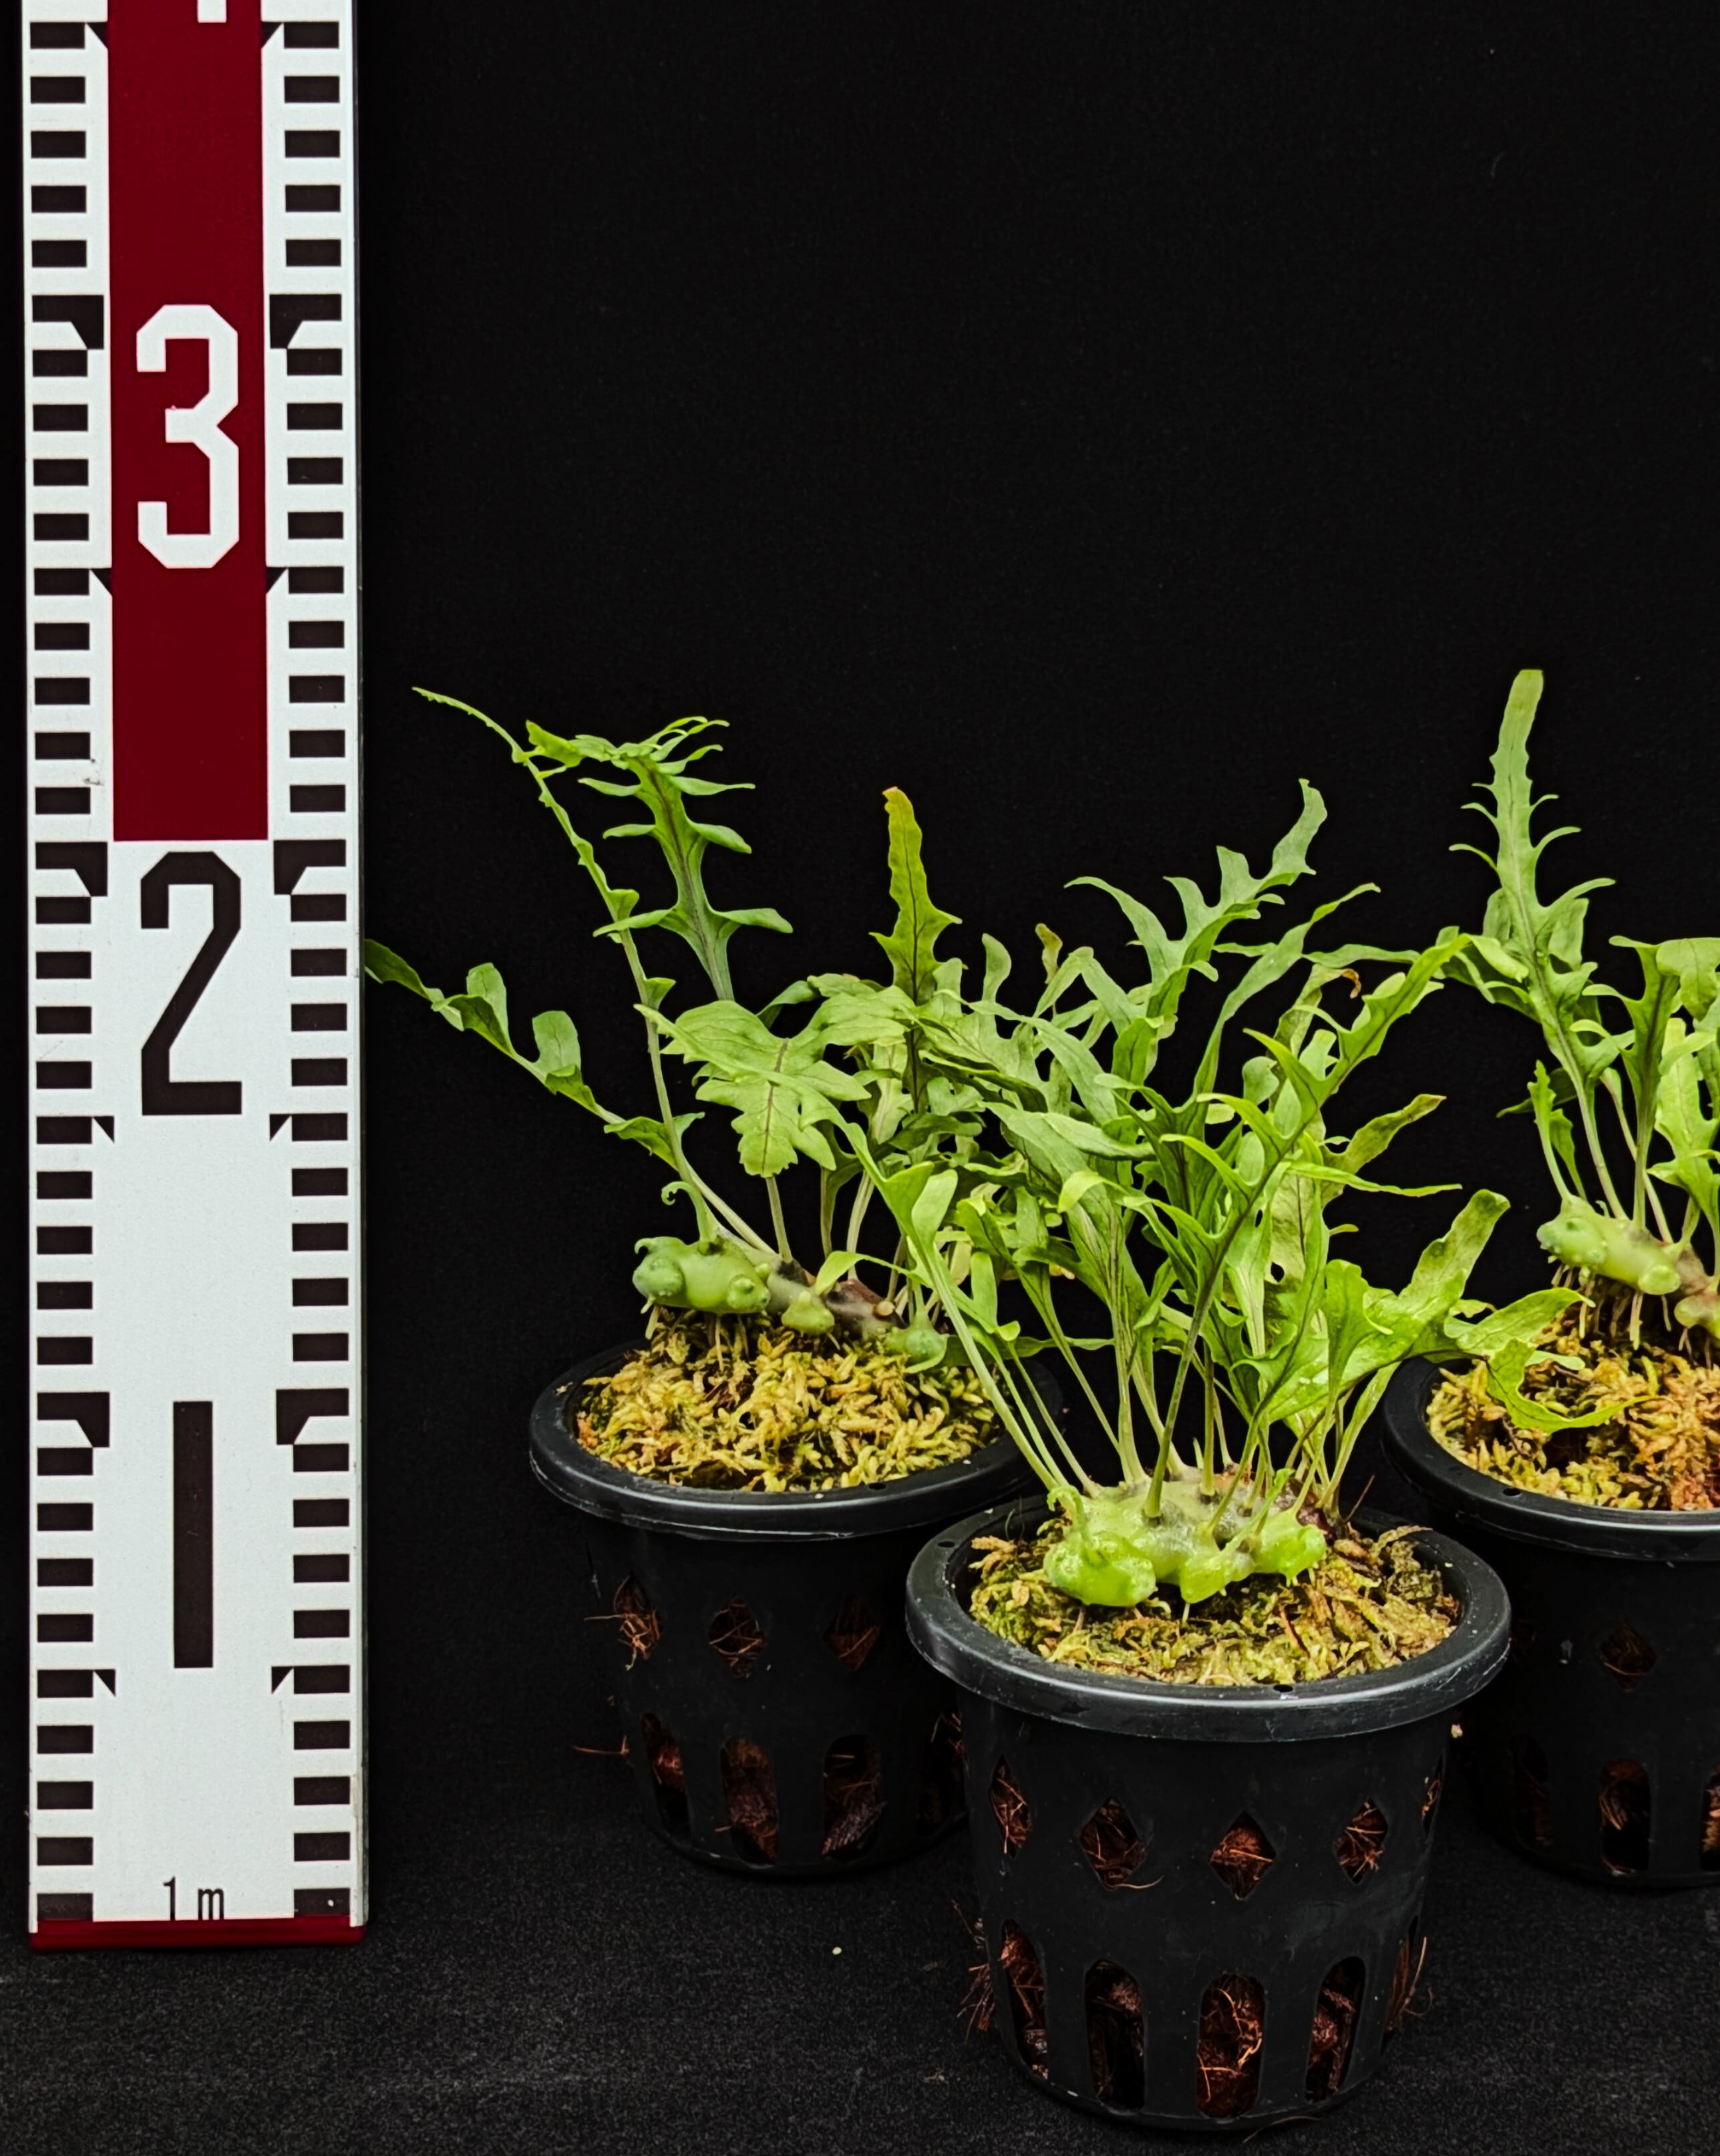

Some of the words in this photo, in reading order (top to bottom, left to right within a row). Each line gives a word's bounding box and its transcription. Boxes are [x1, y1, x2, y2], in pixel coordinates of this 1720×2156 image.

[136, 304, 240, 569] 3
[140, 851, 242, 1116] 2
[172, 1401, 214, 1669] 1
